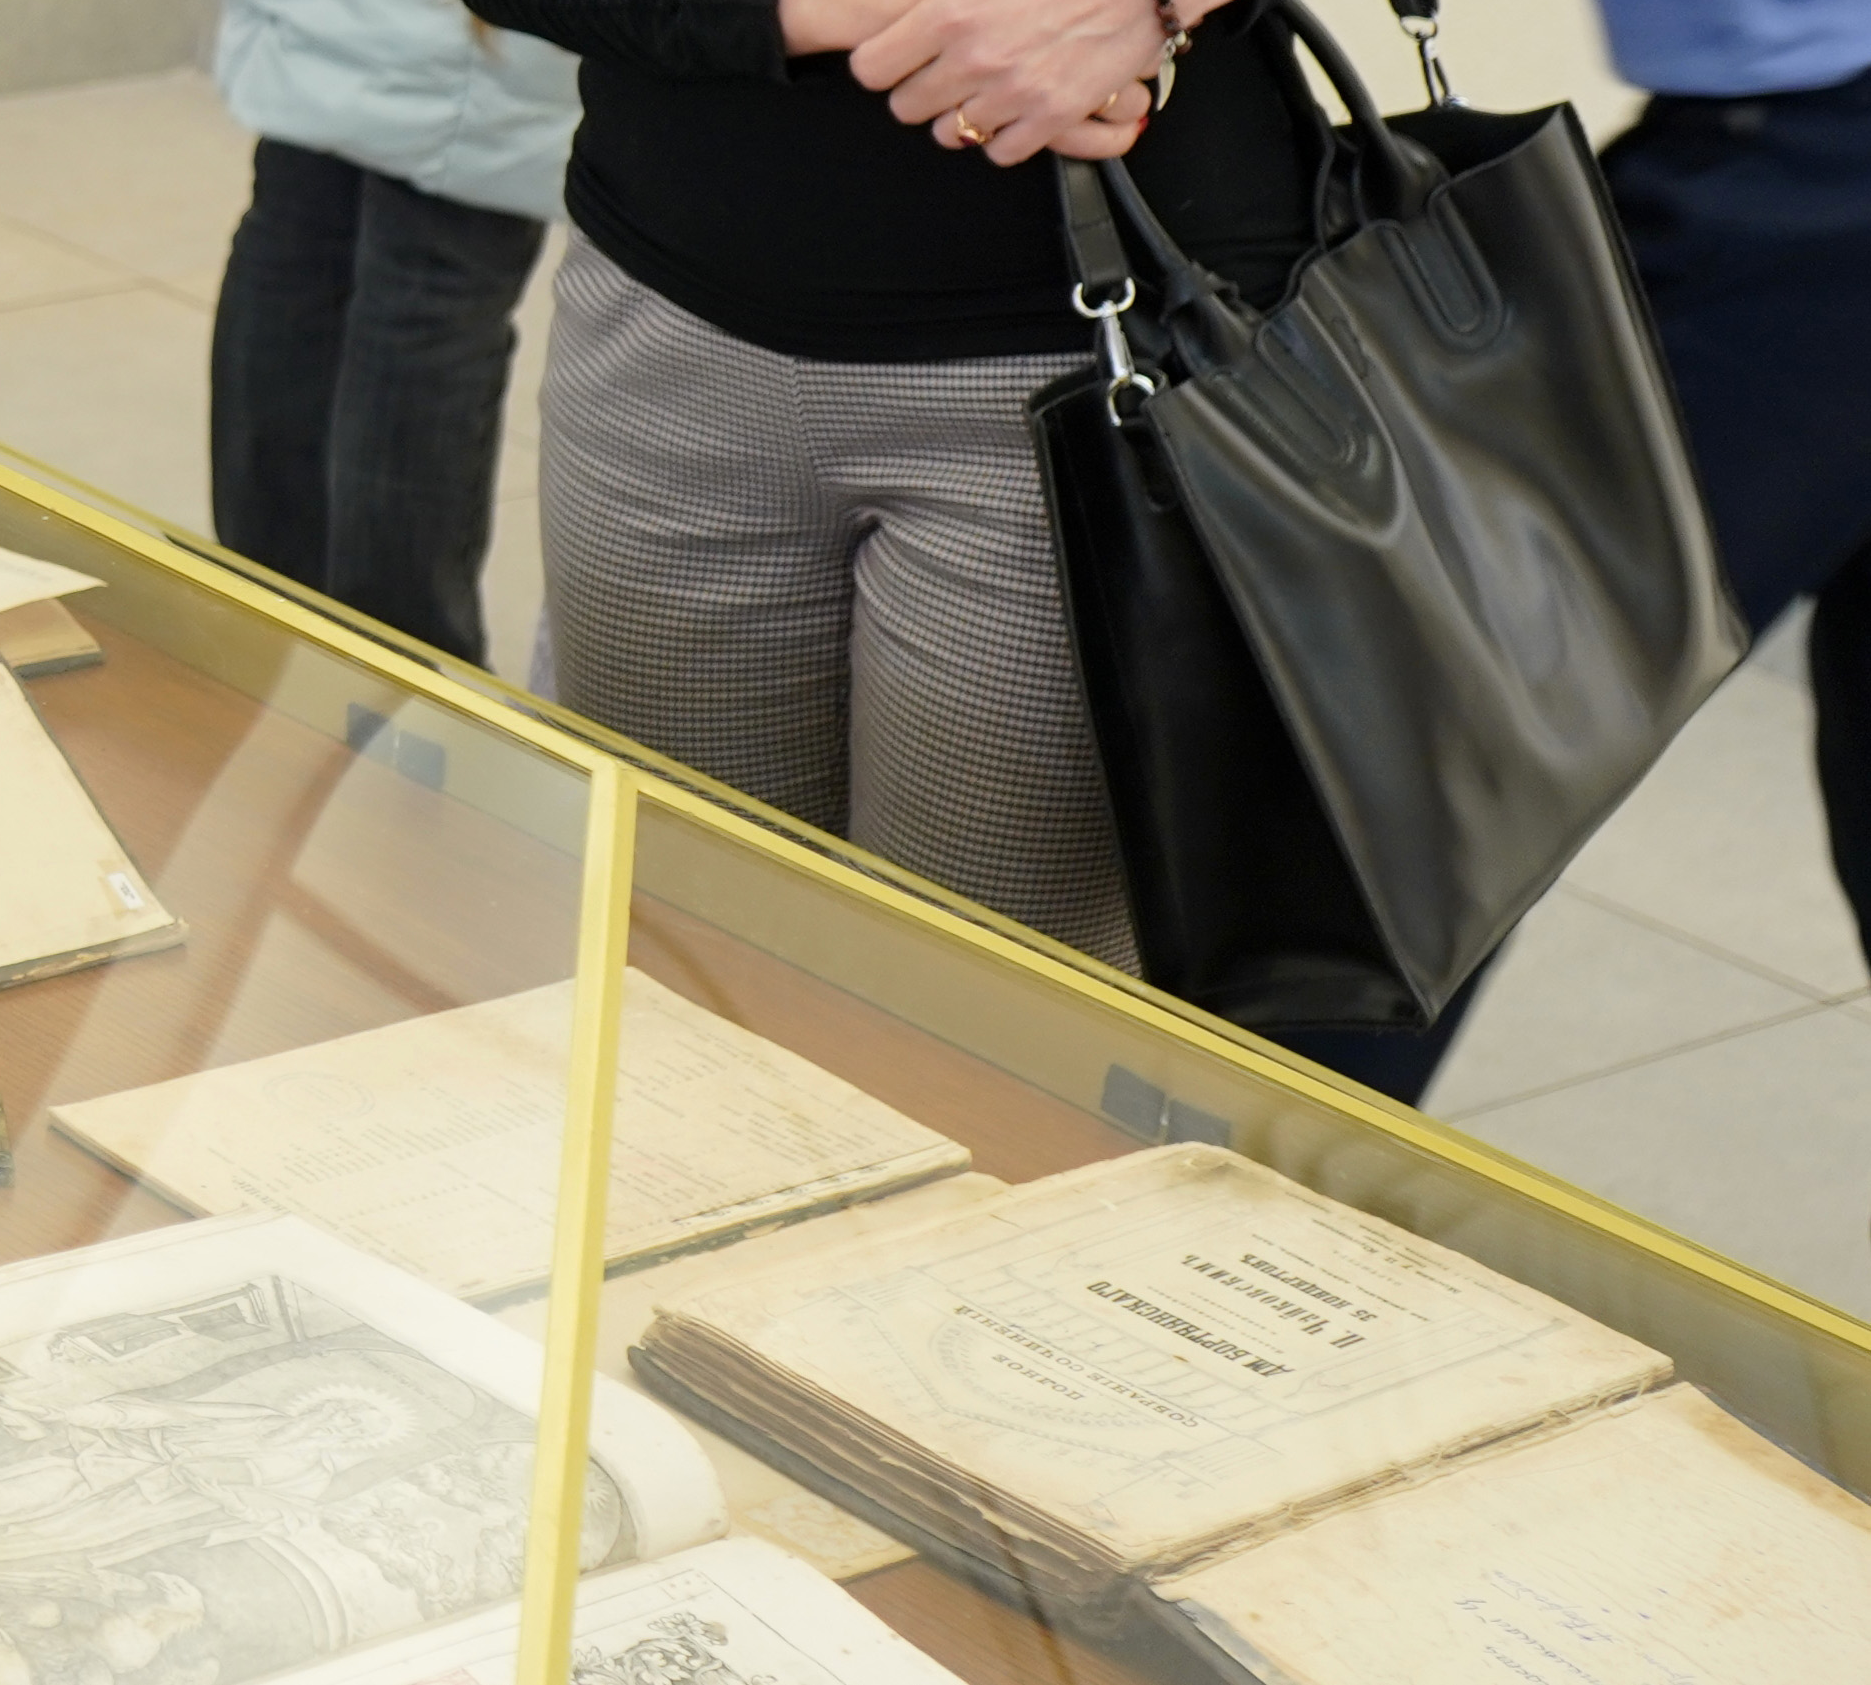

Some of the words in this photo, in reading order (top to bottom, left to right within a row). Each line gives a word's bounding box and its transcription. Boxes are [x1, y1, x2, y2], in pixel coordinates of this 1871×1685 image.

[1163, 1253, 1339, 1335] Чайковскимъ
[1232, 1252, 1355, 1310] КОНЦЕРТОВЪ
[946, 1303, 1091, 1373] СОЧИНЕНІЙ
[1082, 1279, 1253, 1361] БОРТНЯНСКАГО
[1347, 1307, 1380, 1322] 35
[987, 1352, 1088, 1401] ПОЛНОЕ
[1081, 1369, 1205, 1429] СОБРАНІЕ
